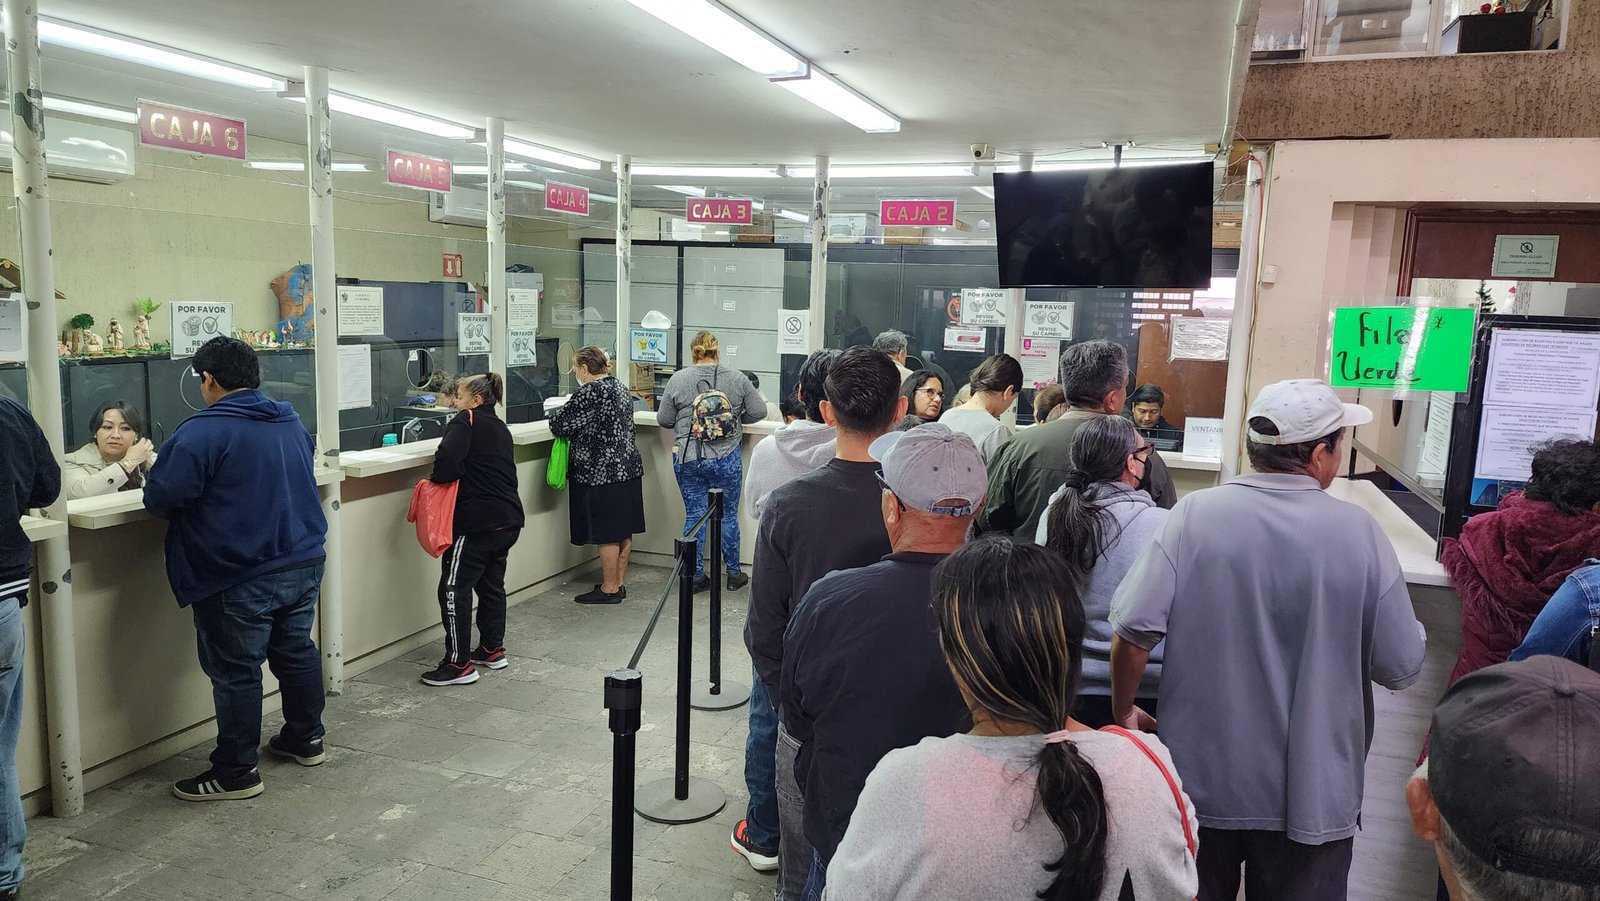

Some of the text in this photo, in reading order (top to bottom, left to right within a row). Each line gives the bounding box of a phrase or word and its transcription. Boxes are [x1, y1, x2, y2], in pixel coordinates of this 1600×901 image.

[150, 112, 239, 151] CAJA 6
[393, 158, 447, 185] CAJA 5
[550, 188, 586, 209] CAJA 4
[692, 203, 746, 219] CAJA 3
[886, 206, 949, 221] CAJA 2
[177, 305, 226, 314] POR FAVOR
